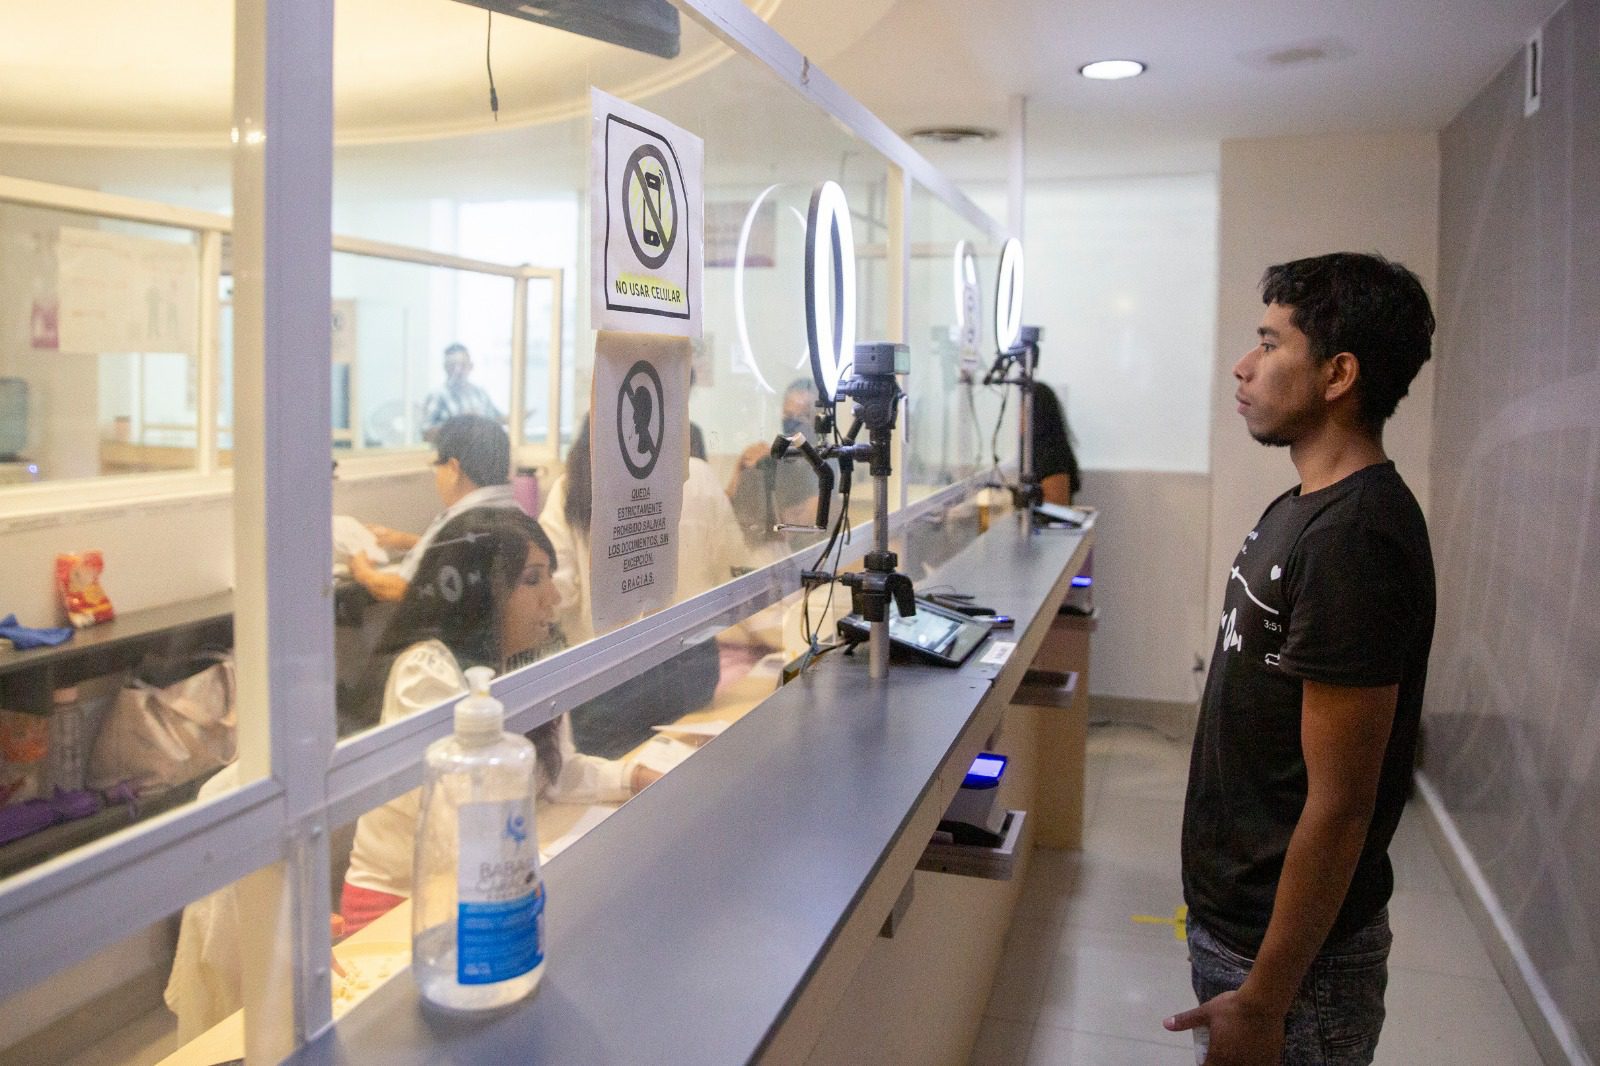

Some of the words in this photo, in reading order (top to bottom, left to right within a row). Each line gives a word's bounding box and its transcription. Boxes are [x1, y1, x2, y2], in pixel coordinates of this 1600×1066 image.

[615, 279, 628, 295] NO
[629, 282, 650, 298] USAR
[651, 286, 681, 303] CELULAR
[631, 487, 650, 500] QUEDA
[617, 502, 663, 519] ESTRICTAMENTE
[613, 521, 642, 537] PROHIBIDO
[642, 517, 666, 531] SALIVAR
[608, 543, 621, 557] LOS
[1263, 619, 1282, 633] 3:51
